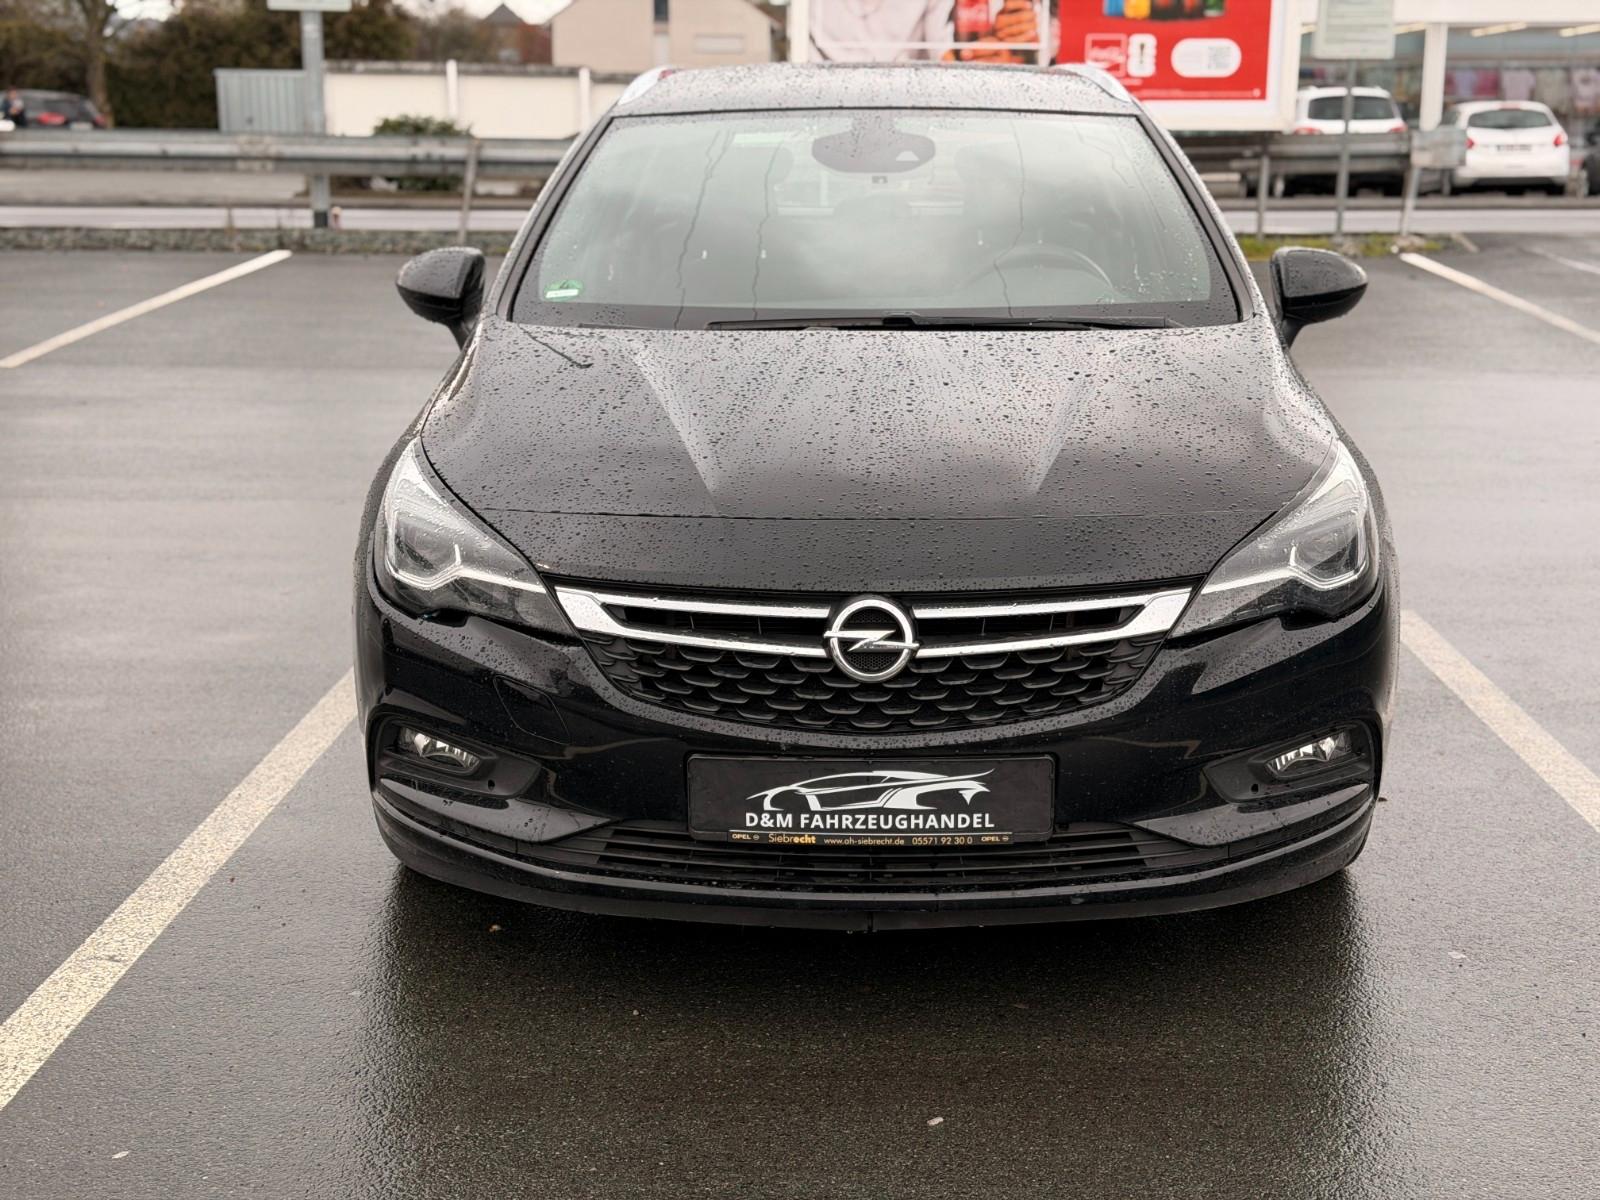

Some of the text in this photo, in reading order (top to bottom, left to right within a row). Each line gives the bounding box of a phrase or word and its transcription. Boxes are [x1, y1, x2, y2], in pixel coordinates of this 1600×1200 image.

[745, 812, 995, 829] D&M FAHRZEUGHANDEL
[768, 833, 816, 844] Siebrecht
[912, 837, 938, 845] 05571
[940, 836, 951, 845] 92
[954, 836, 965, 845] 30
[967, 836, 973, 845] 0
